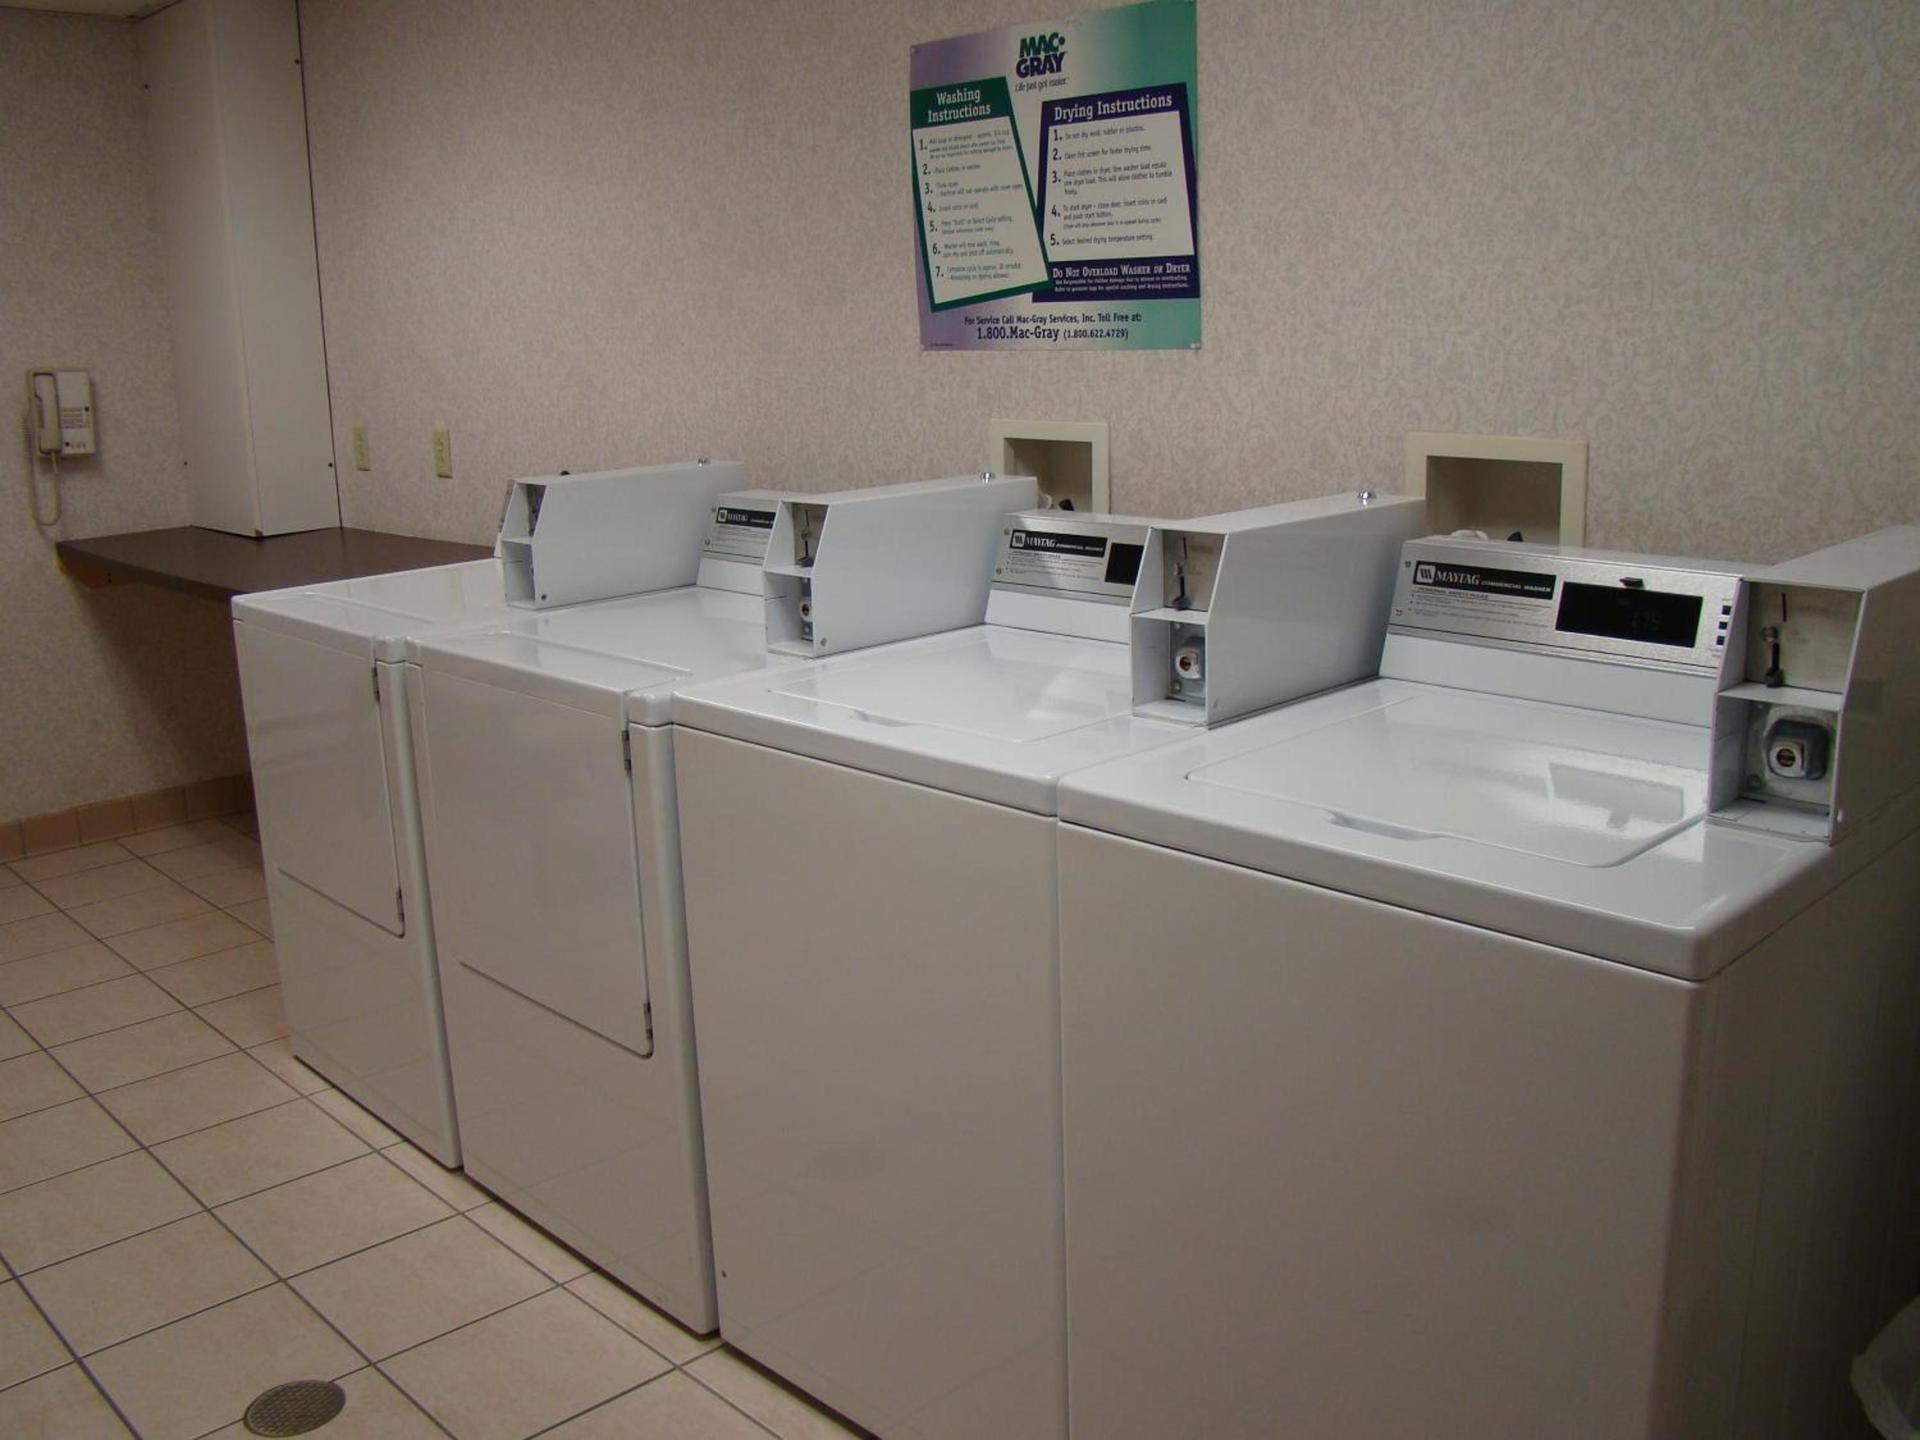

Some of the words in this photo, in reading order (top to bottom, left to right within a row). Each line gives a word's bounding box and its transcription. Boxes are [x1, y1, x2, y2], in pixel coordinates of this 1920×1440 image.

[1016, 51, 1067, 78] GRAY
[936, 88, 981, 105] Washing
[928, 103, 991, 123] Instructions
[1054, 103, 1093, 122] Drying
[1097, 94, 1173, 115] Instructions
[1053, 129, 1062, 141] 1.
[1052, 148, 1062, 161] 2.
[1052, 171, 1061, 183] 3.
[1051, 205, 1060, 217] 4.
[1050, 234, 1060, 246] 5.
[964, 317, 975, 325] For
[976, 316, 1000, 325] Service
[1002, 315, 1014, 324] Call
[1016, 315, 1048, 326] Mac-Gray
[1049, 314, 1079, 324] Services,
[1082, 314, 1096, 323] Inc.
[1098, 314, 1111, 322] Toll
[1113, 314, 1129, 322] Free
[1131, 313, 1142, 322] at:
[977, 326, 1059, 342] 1.800.Mac-Gray
[1026, 537, 1056, 548] MAYTAG
[1435, 571, 1480, 586] MAYTAG
[1523, 585, 1551, 593] WASHER
